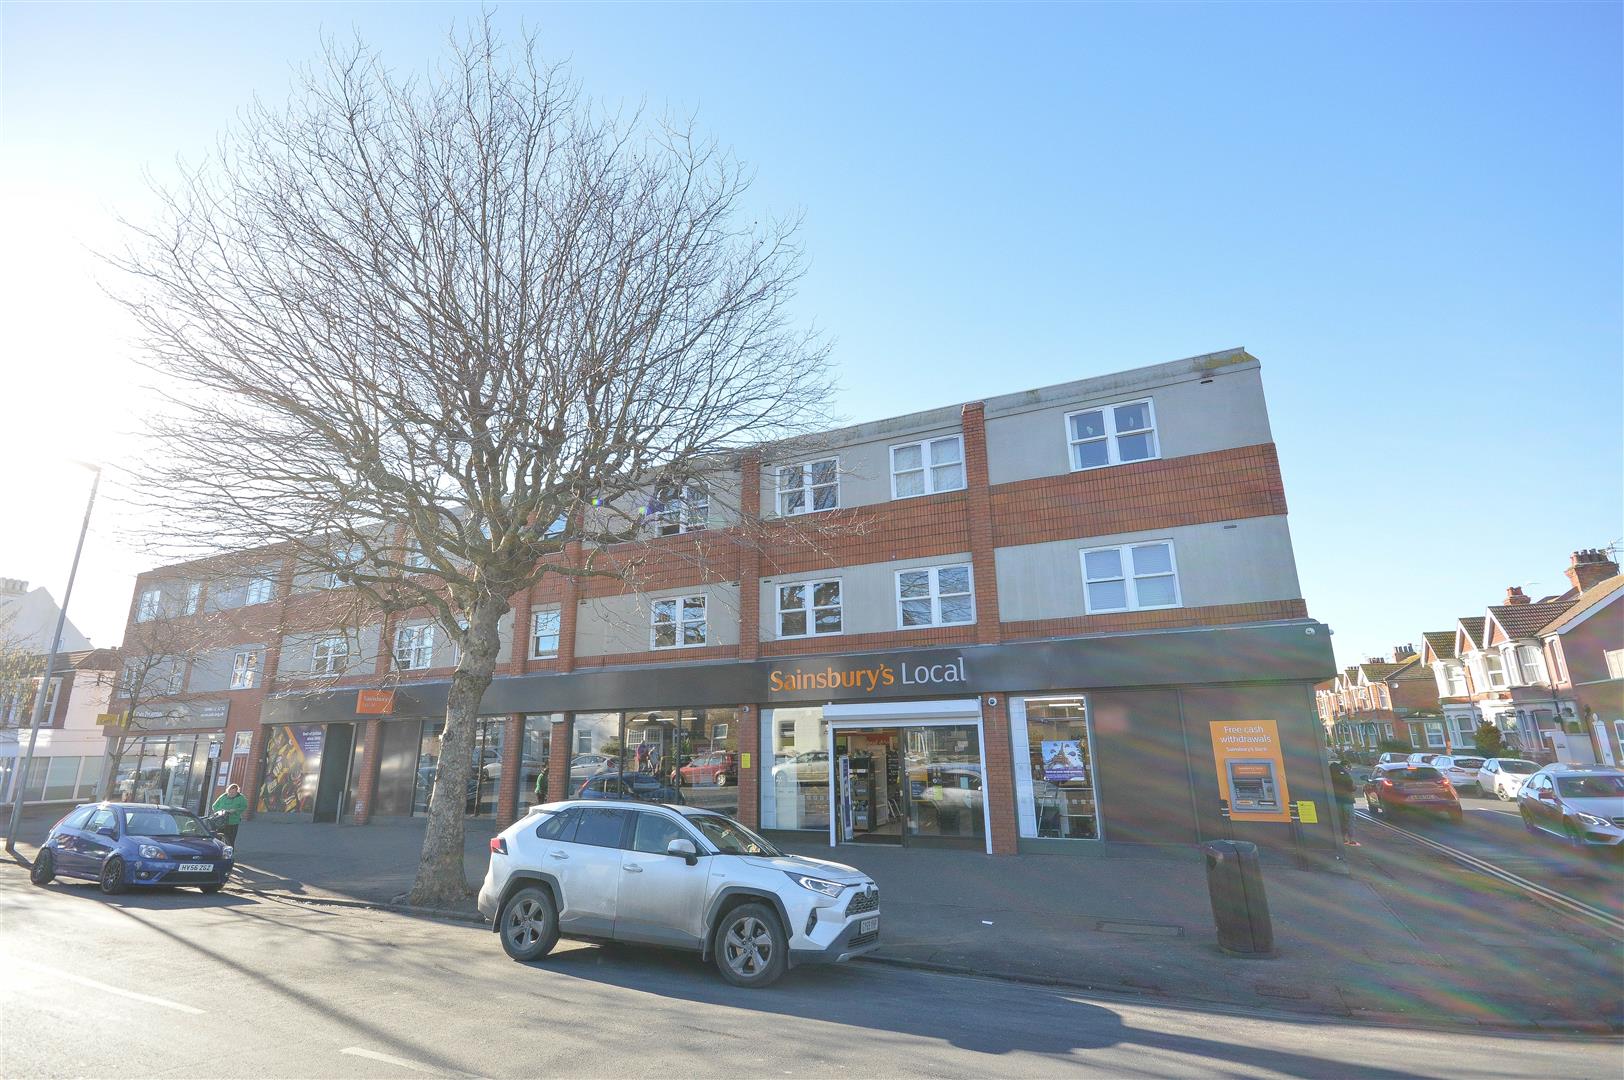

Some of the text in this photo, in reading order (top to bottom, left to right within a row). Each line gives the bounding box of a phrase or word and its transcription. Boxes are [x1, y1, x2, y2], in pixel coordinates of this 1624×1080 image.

[770, 657, 966, 693] Sainsbury's Local
[1224, 724, 1264, 733] Free cash
[1219, 734, 1272, 743] withdrawals
